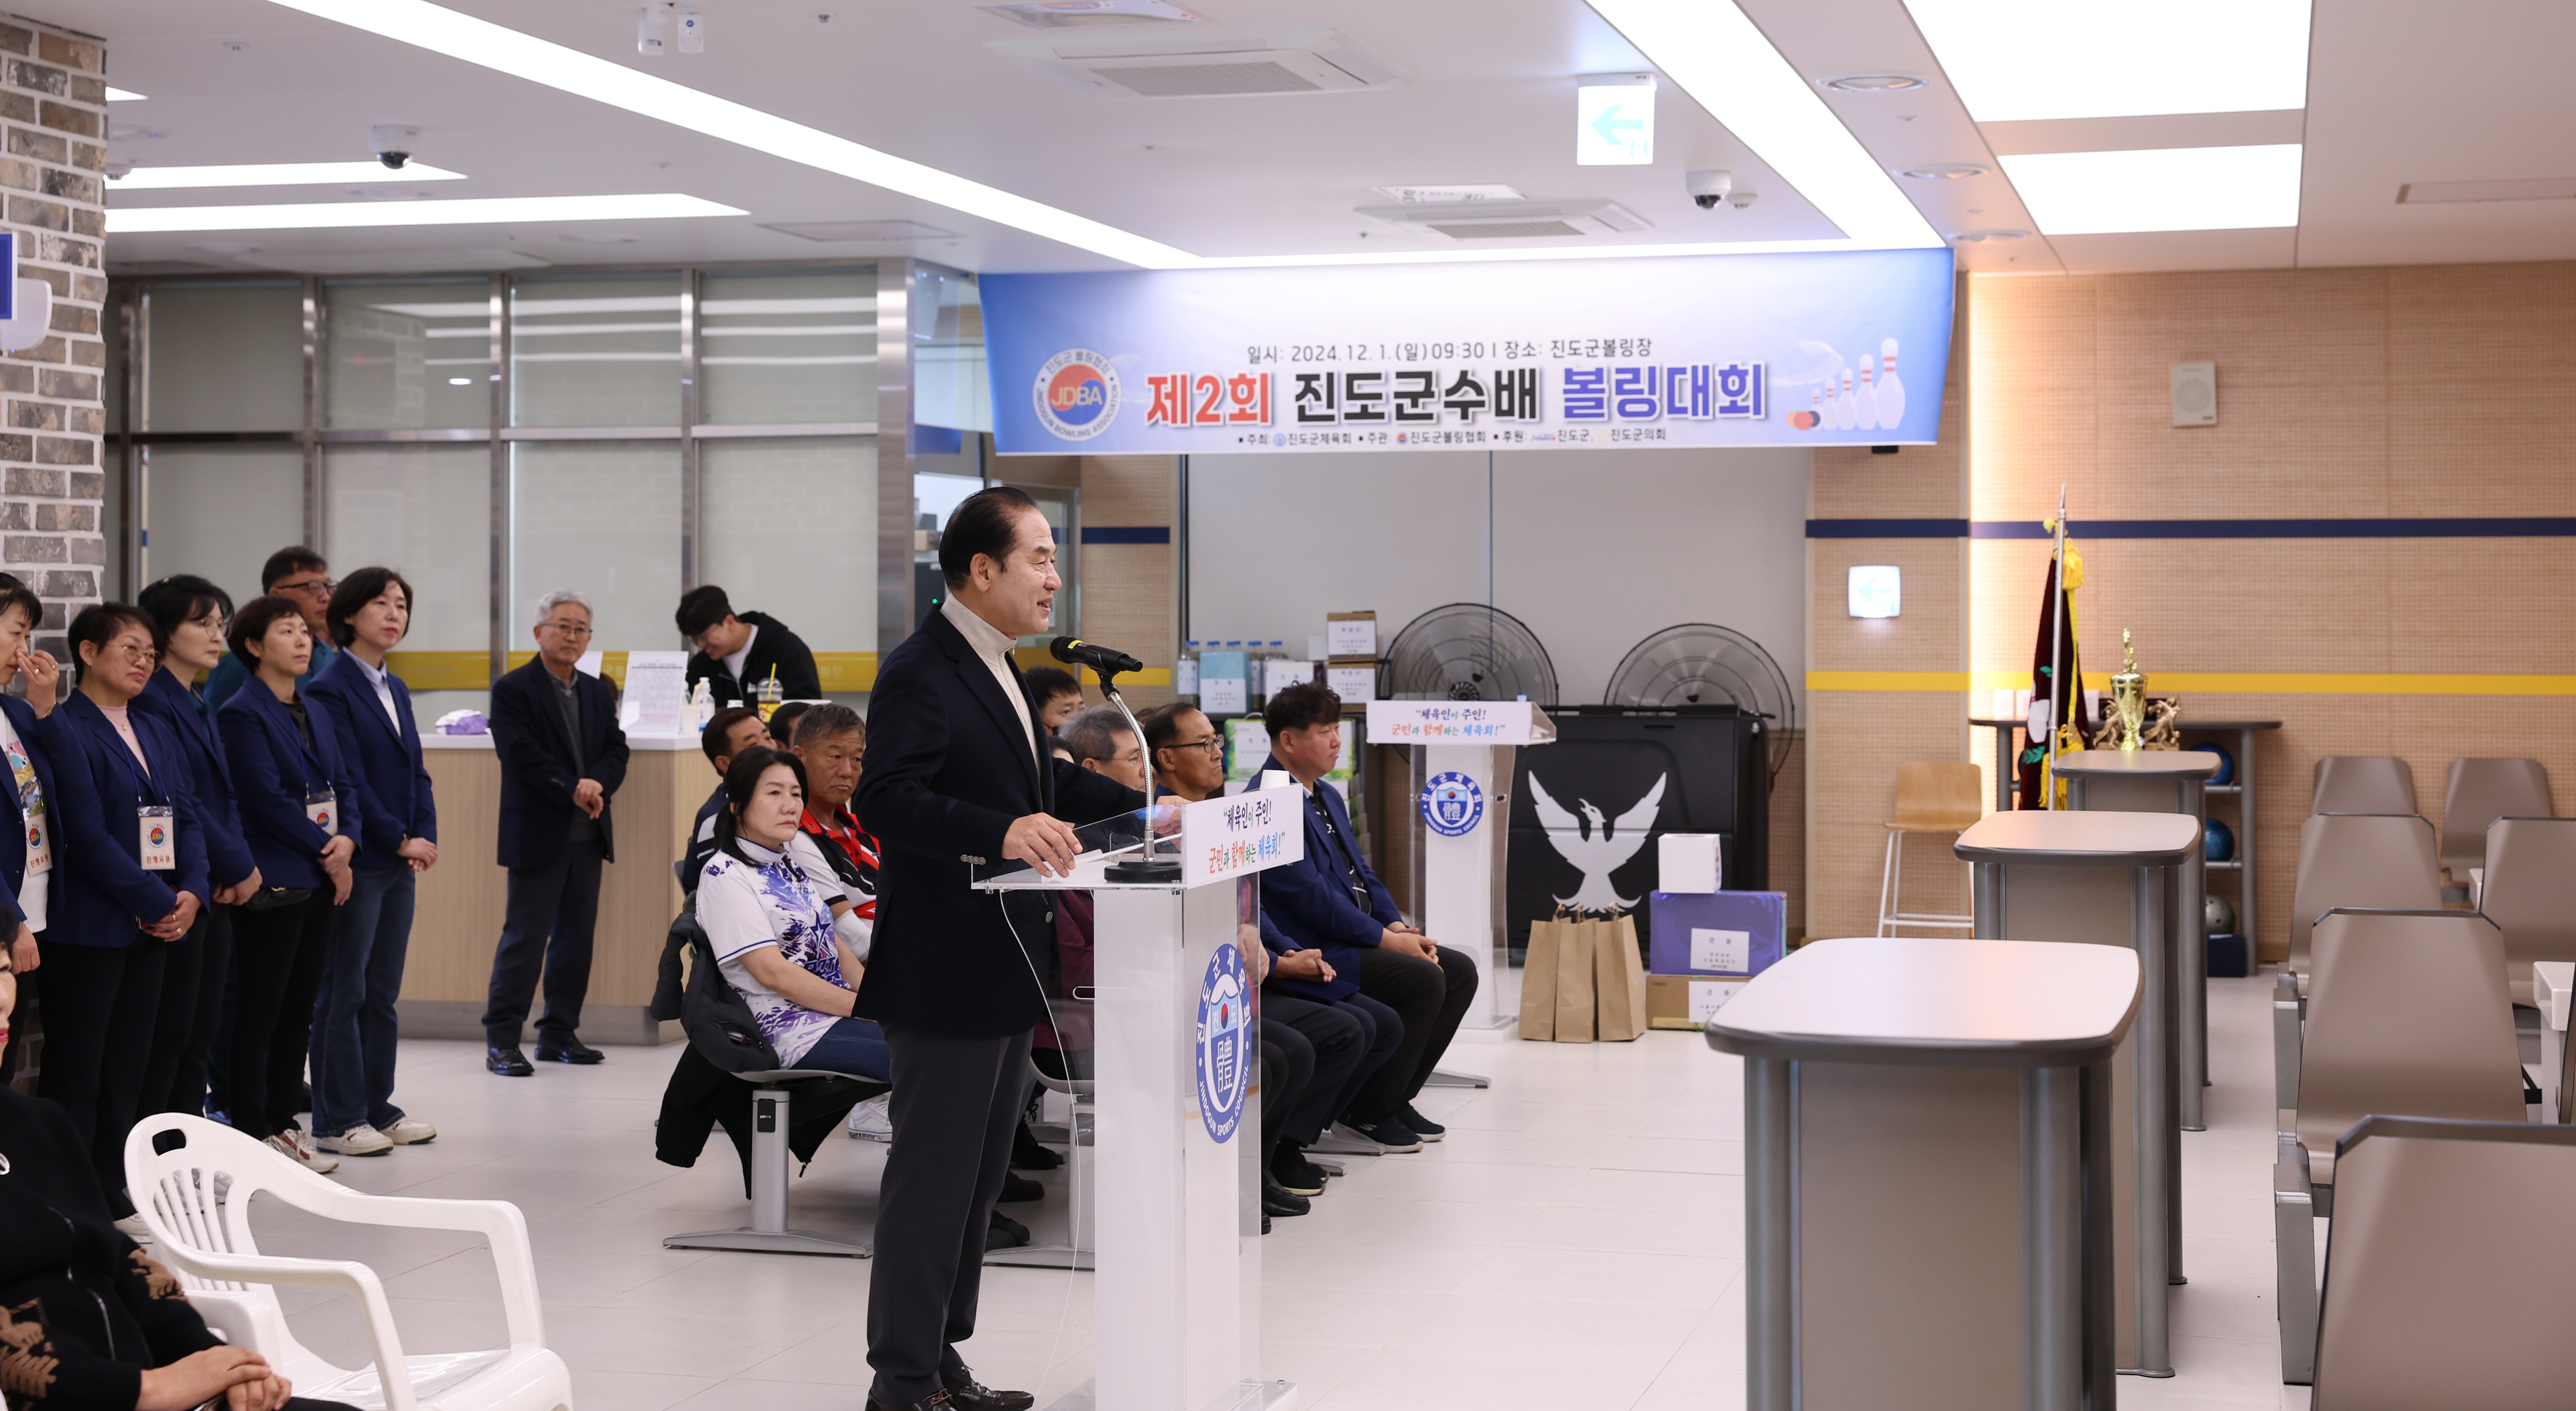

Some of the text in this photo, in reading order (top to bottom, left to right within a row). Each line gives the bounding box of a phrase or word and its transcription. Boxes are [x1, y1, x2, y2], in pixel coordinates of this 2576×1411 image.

[1247, 345, 1283, 364] 일시:
[1505, 340, 1543, 360] 장소:
[1550, 338, 1652, 358] 진도군볼링장
[1049, 386, 1103, 406] JDBA
[1145, 363, 1763, 425] 제2회 진도군수배 볼링대회
[1287, 432, 1352, 446] 진도군체육회
[1410, 430, 1486, 444] 진도군볼링협회
[1610, 427, 1666, 441] 진도군의회
[1461, 708, 1487, 721] 주인!
[1391, 724, 1420, 736] 군민과
[1423, 724, 1460, 736] 함께하는
[1256, 798, 1272, 828] 주인!
[1208, 844, 1229, 874] 군민과
[1231, 839, 1256, 868] 함께하는
[1197, 946, 1252, 1044] 진도군체육회
[1216, 1036, 1233, 1094] 體
[1199, 1064, 1249, 1137] JINDOGUN SPORTS COUNCIL
